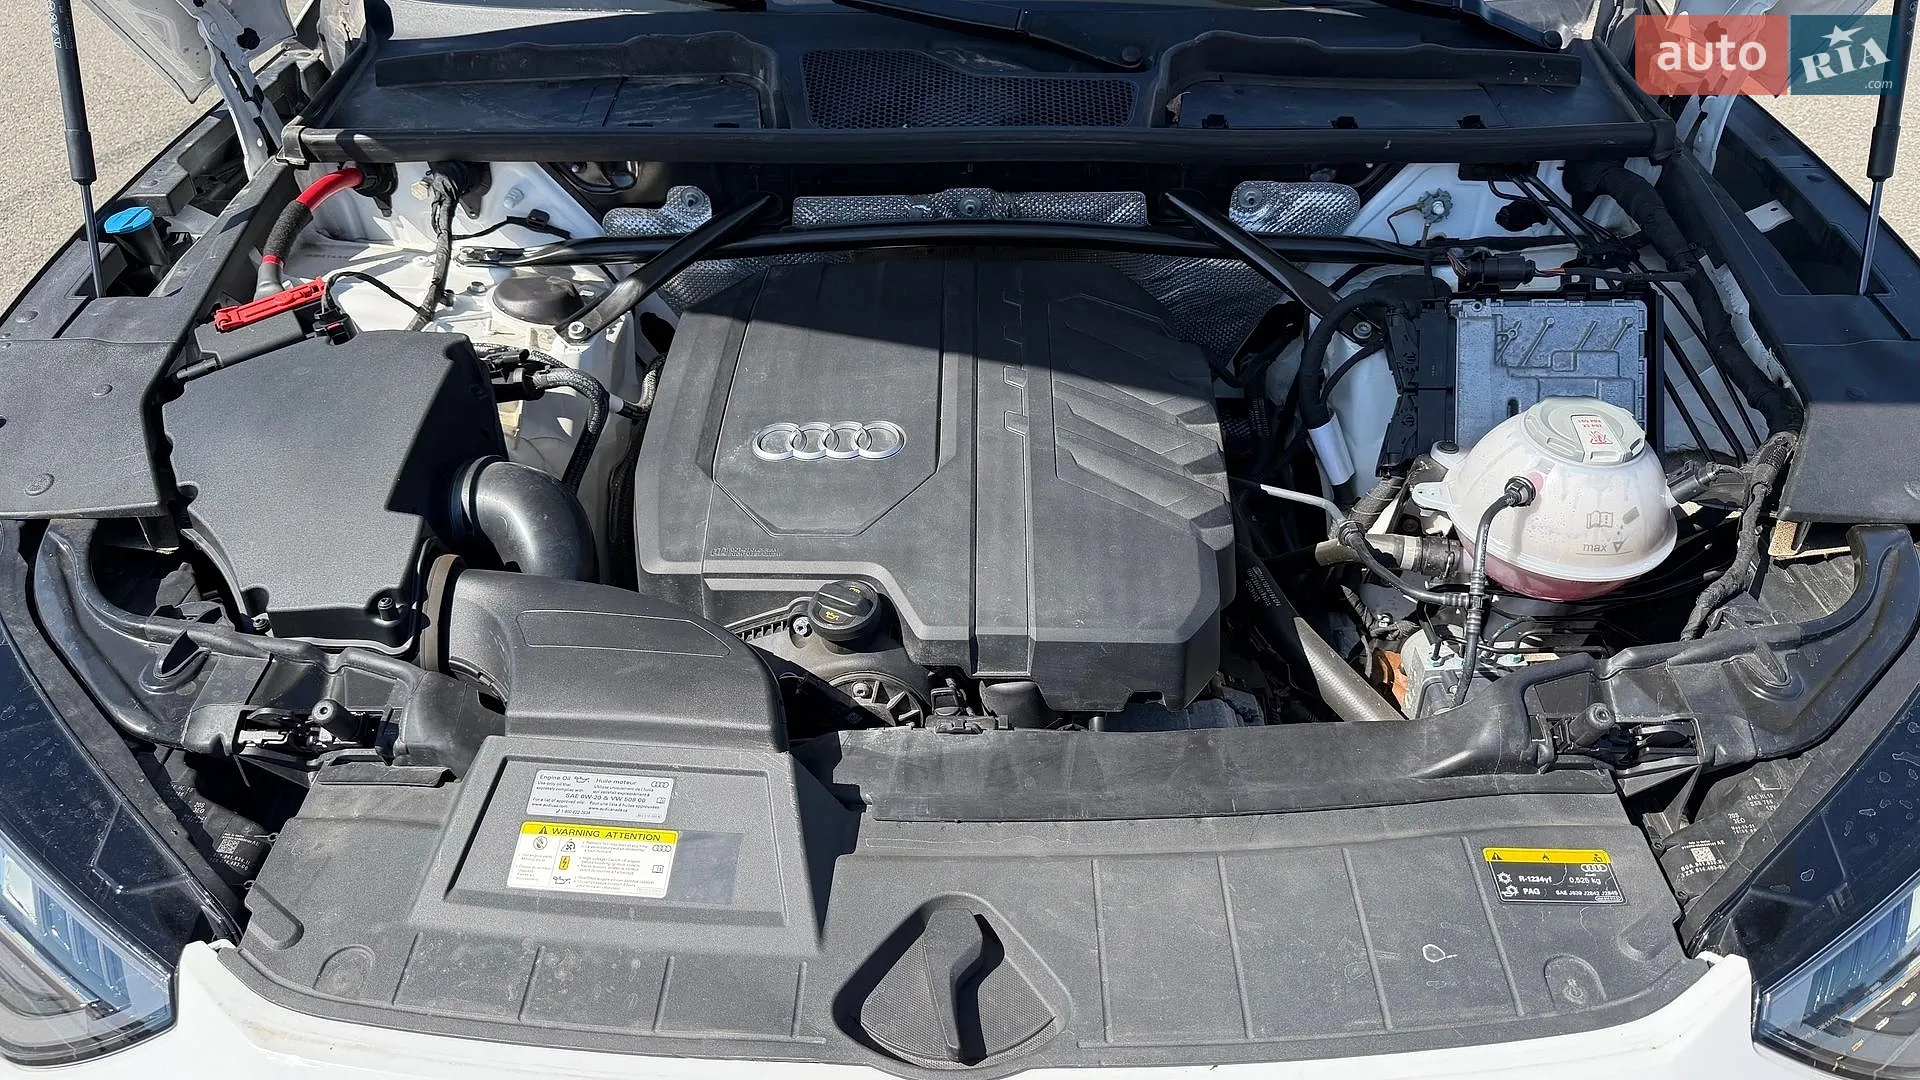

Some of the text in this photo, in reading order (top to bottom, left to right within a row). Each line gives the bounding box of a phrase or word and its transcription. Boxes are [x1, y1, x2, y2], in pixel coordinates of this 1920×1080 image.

[1583, 542, 1607, 552] max
[551, 827, 661, 842] WARNING ATTENTION
[1518, 875, 1602, 885] R-1234yf 0,525 kg
